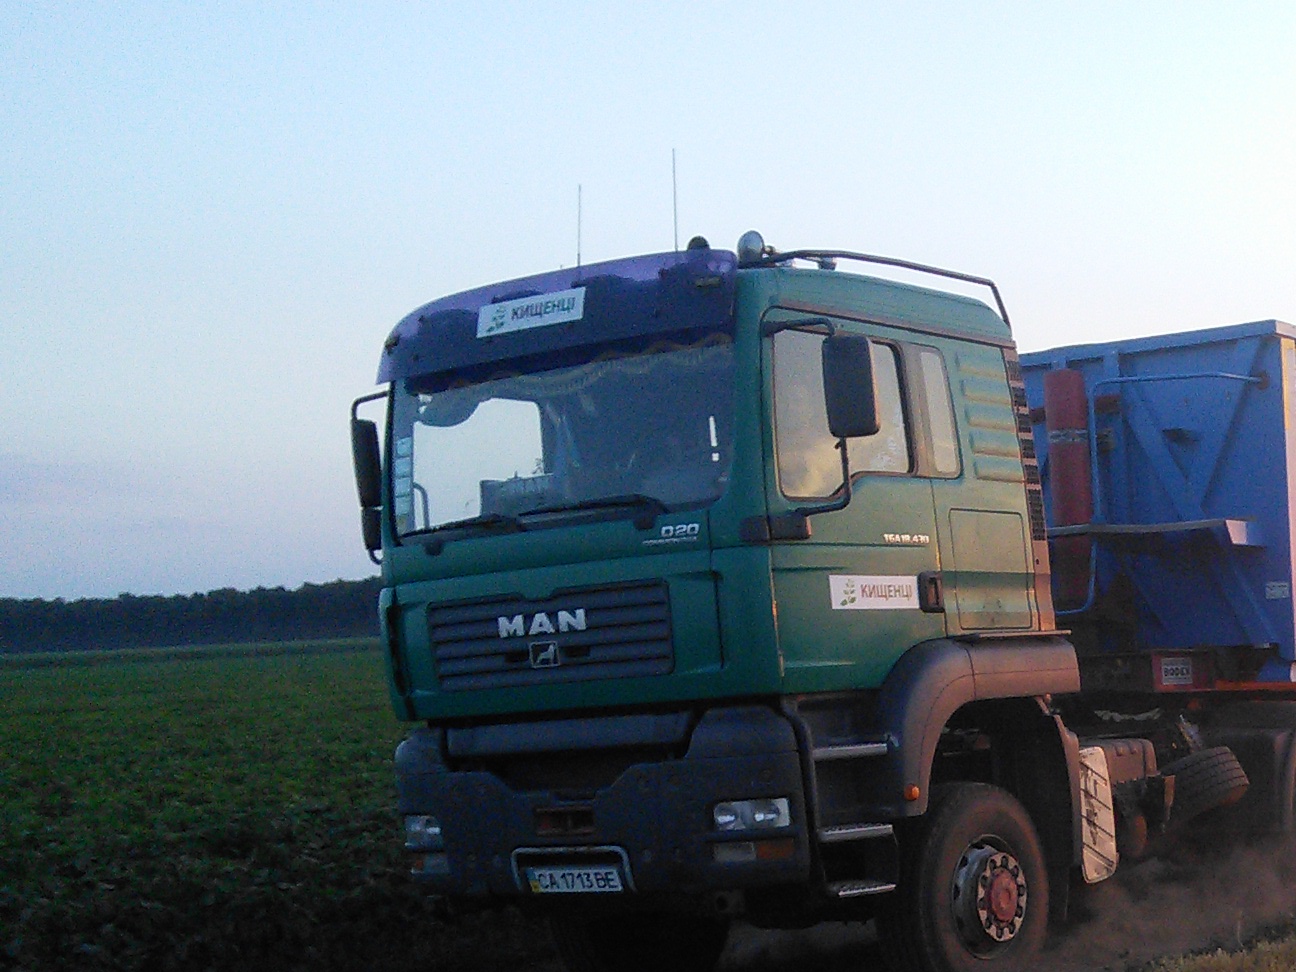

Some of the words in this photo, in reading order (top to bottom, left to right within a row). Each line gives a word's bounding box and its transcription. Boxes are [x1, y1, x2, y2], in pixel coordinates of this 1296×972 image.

[511, 297, 576, 321] КИЩЕНЦІ
[860, 584, 913, 601] КИЩЕНЦІ
[498, 608, 587, 639] MAN
